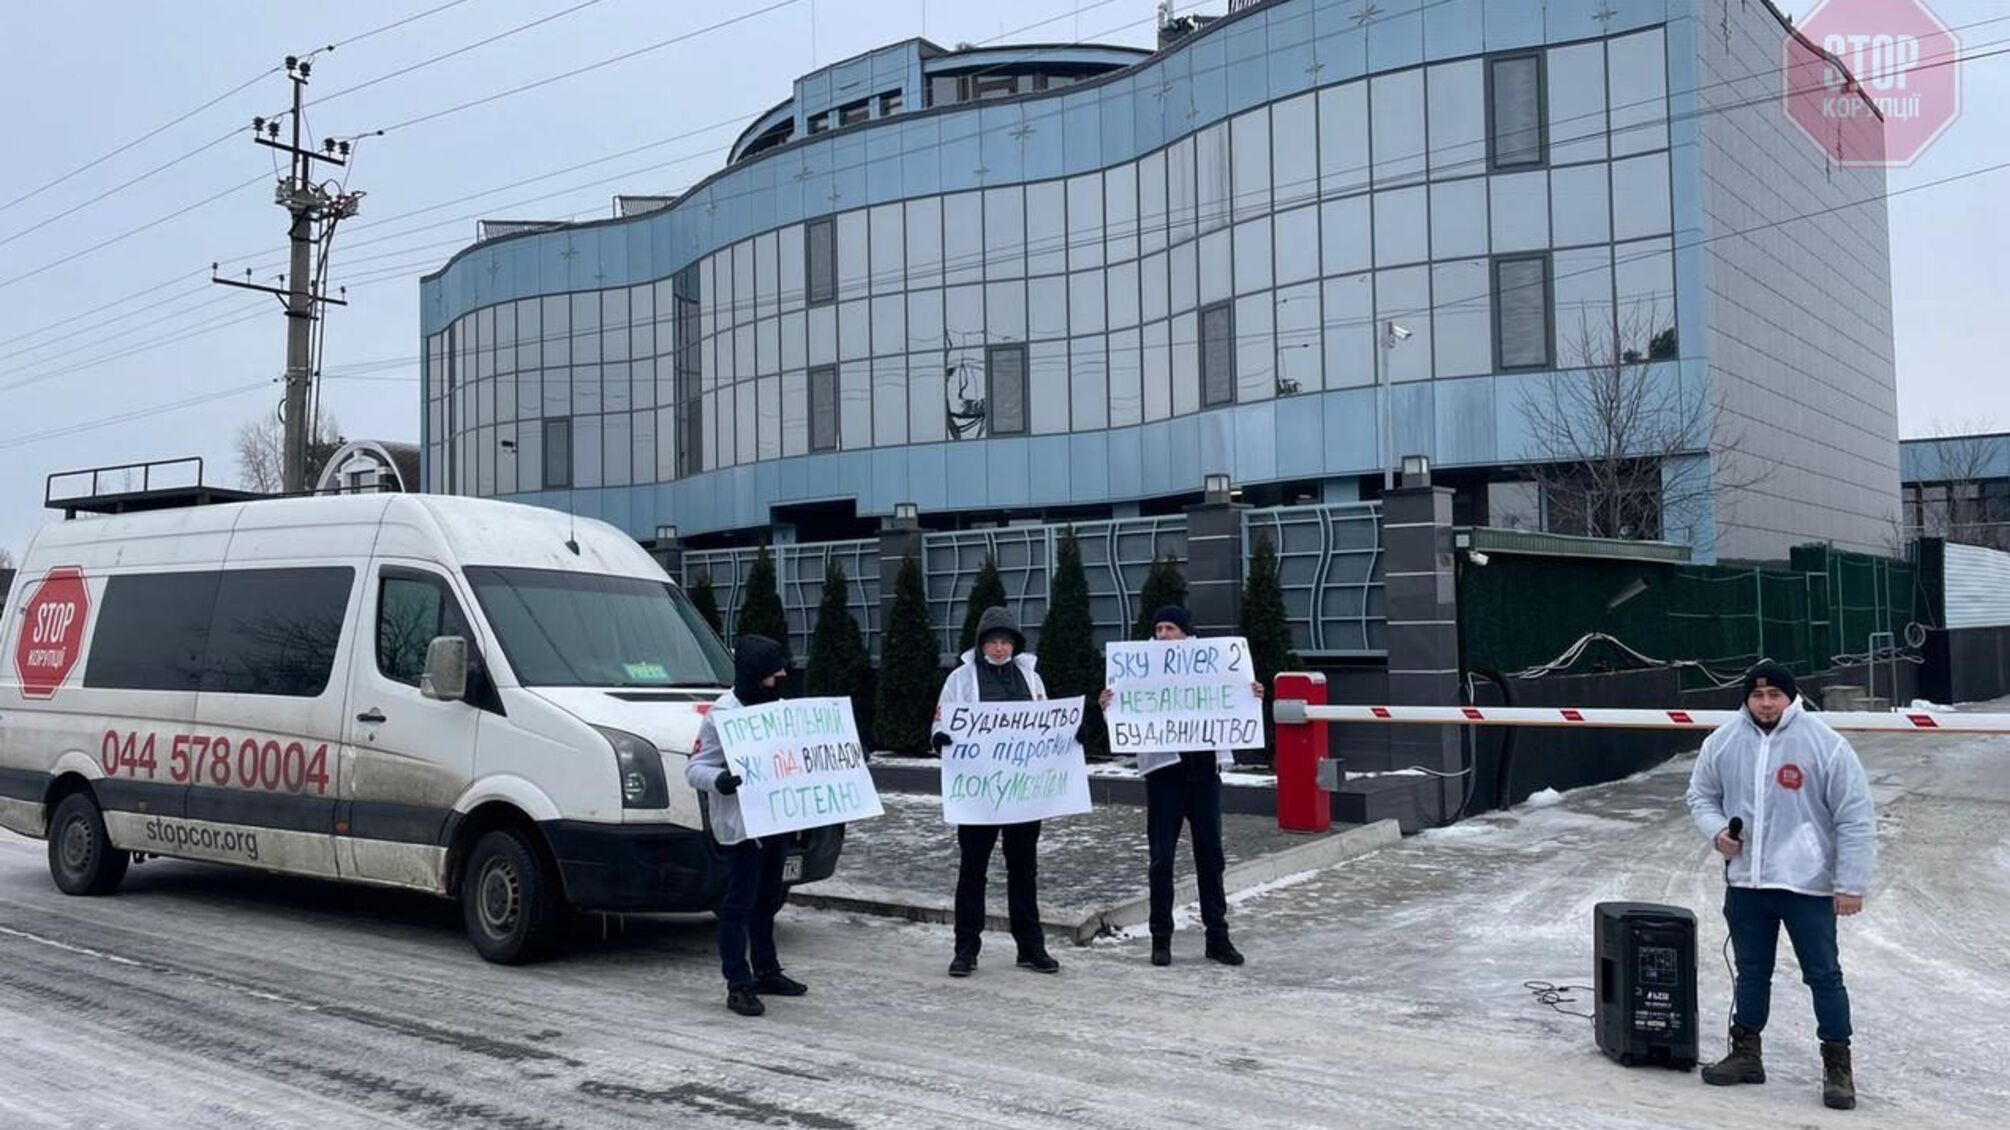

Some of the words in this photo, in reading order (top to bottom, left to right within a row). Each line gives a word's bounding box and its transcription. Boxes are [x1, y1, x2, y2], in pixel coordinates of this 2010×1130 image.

[33, 602, 75, 643] STOP
[1120, 685, 1235, 713] НЕЗАКОННЕ
[102, 730, 157, 779] 044
[170, 735, 231, 786] 578
[238, 738, 329, 795] 0004
[768, 781, 860, 822] ГОТЕЛЮ
[146, 817, 259, 860] stopcor.org
